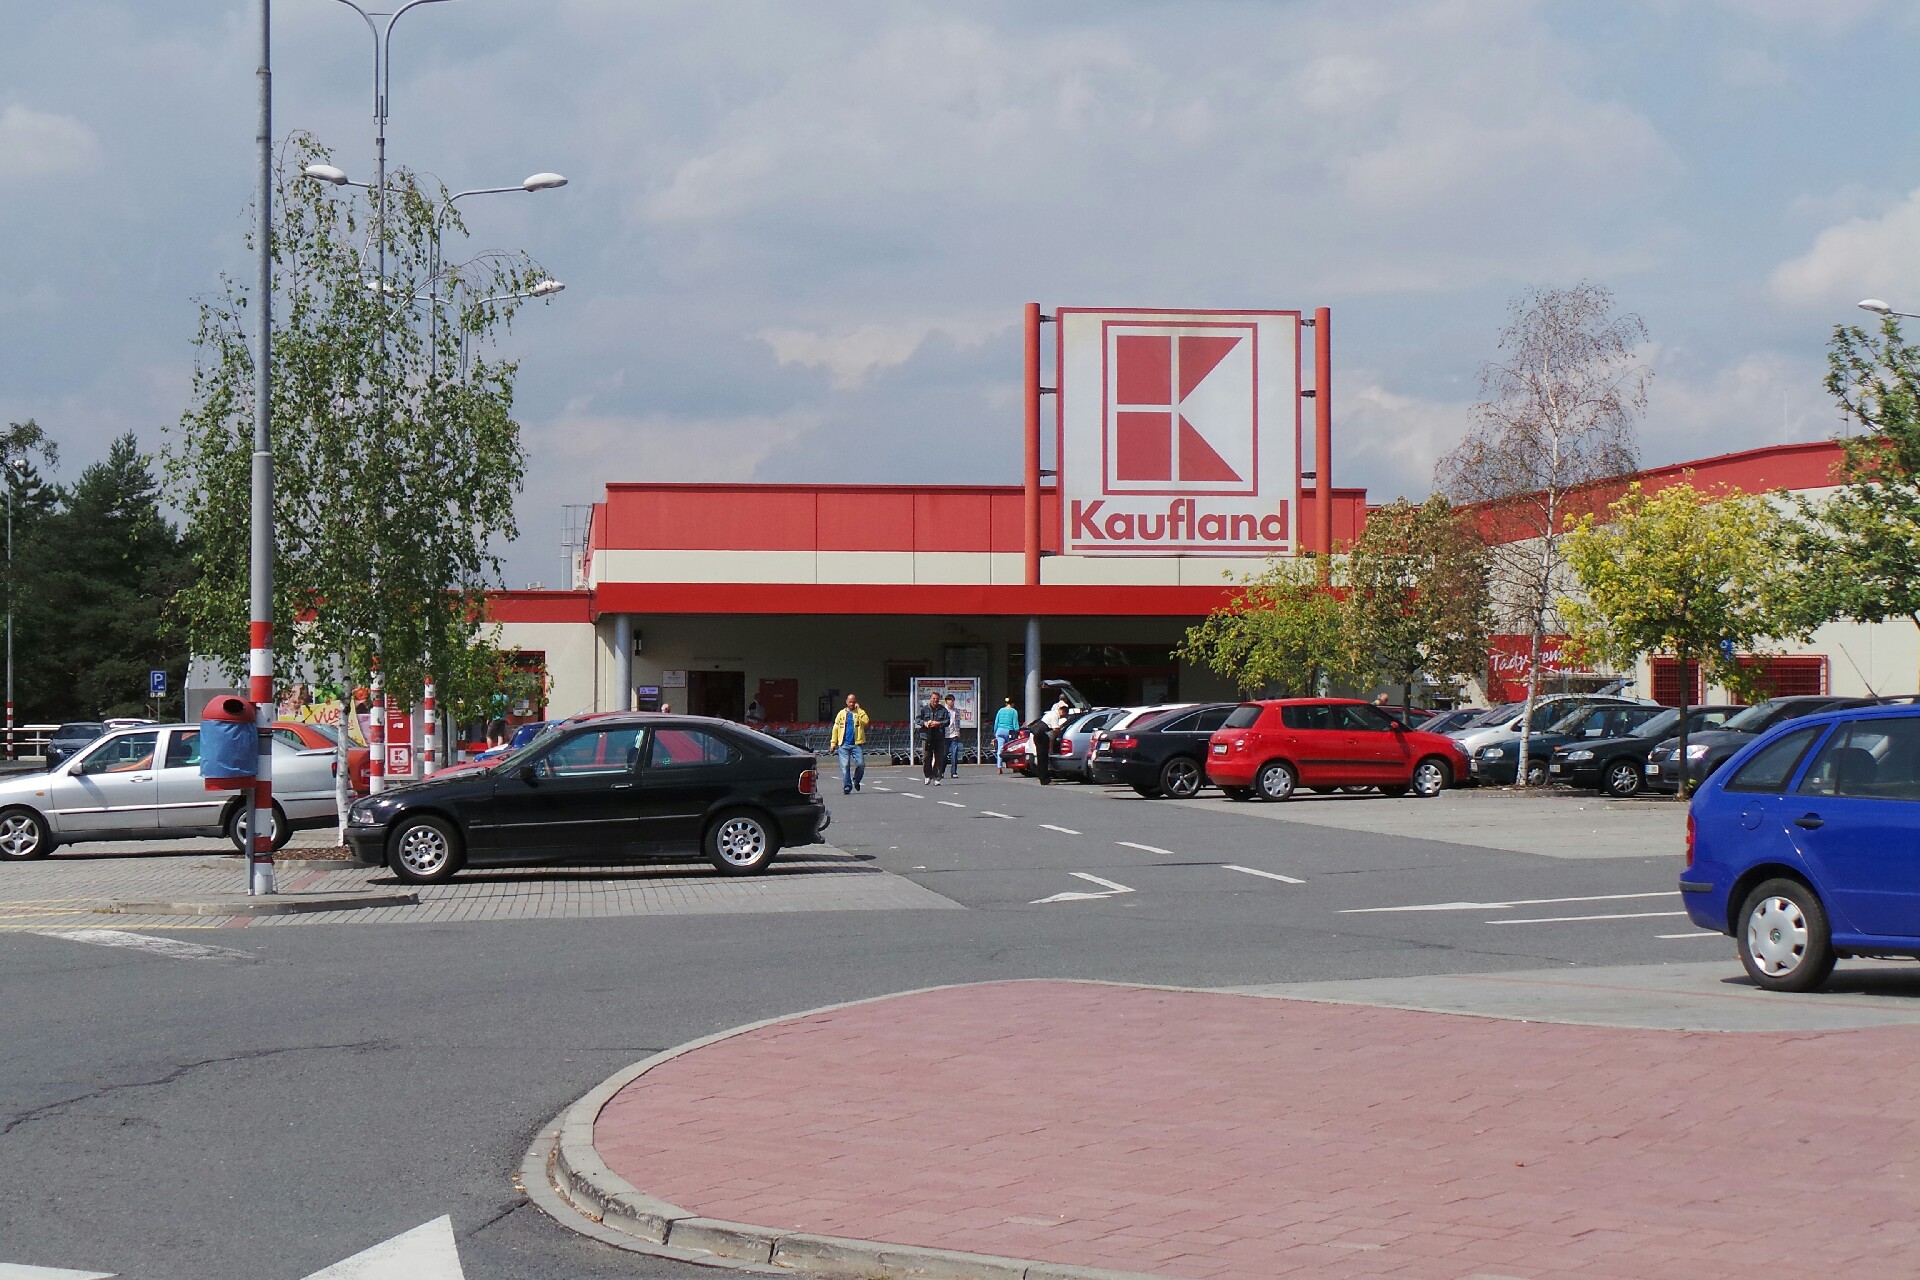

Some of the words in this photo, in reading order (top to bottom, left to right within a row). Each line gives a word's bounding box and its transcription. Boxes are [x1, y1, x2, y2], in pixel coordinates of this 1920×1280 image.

[1117, 335, 1243, 482] K
[1071, 498, 1289, 541] Kaufland
[1490, 650, 1529, 673] Tady
[154, 673, 164, 686] P
